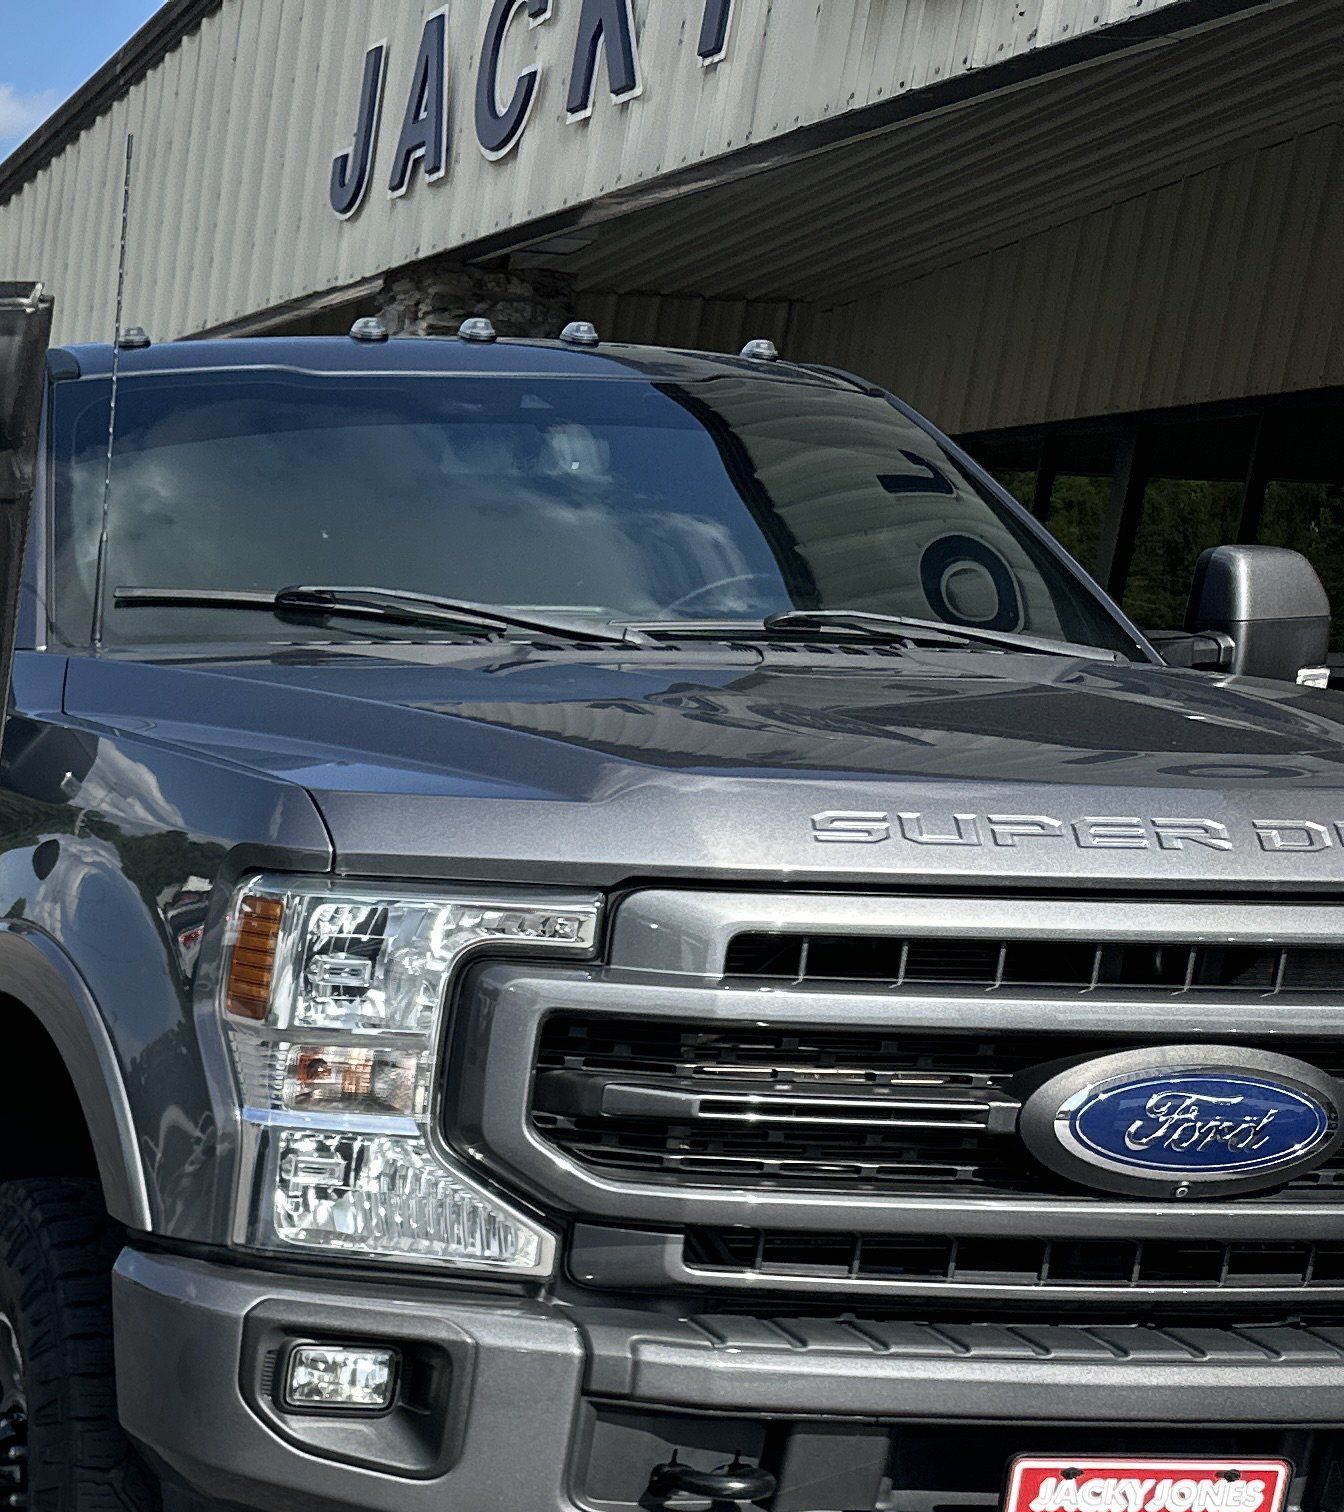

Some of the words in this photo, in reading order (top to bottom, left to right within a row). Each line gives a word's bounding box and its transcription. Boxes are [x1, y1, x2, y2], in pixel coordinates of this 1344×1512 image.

[811, 810, 1233, 851] SUPER
[1251, 817, 1344, 852] D
[1124, 1090, 1279, 1153] Ford
[1029, 1477, 1157, 1512] JACKY
